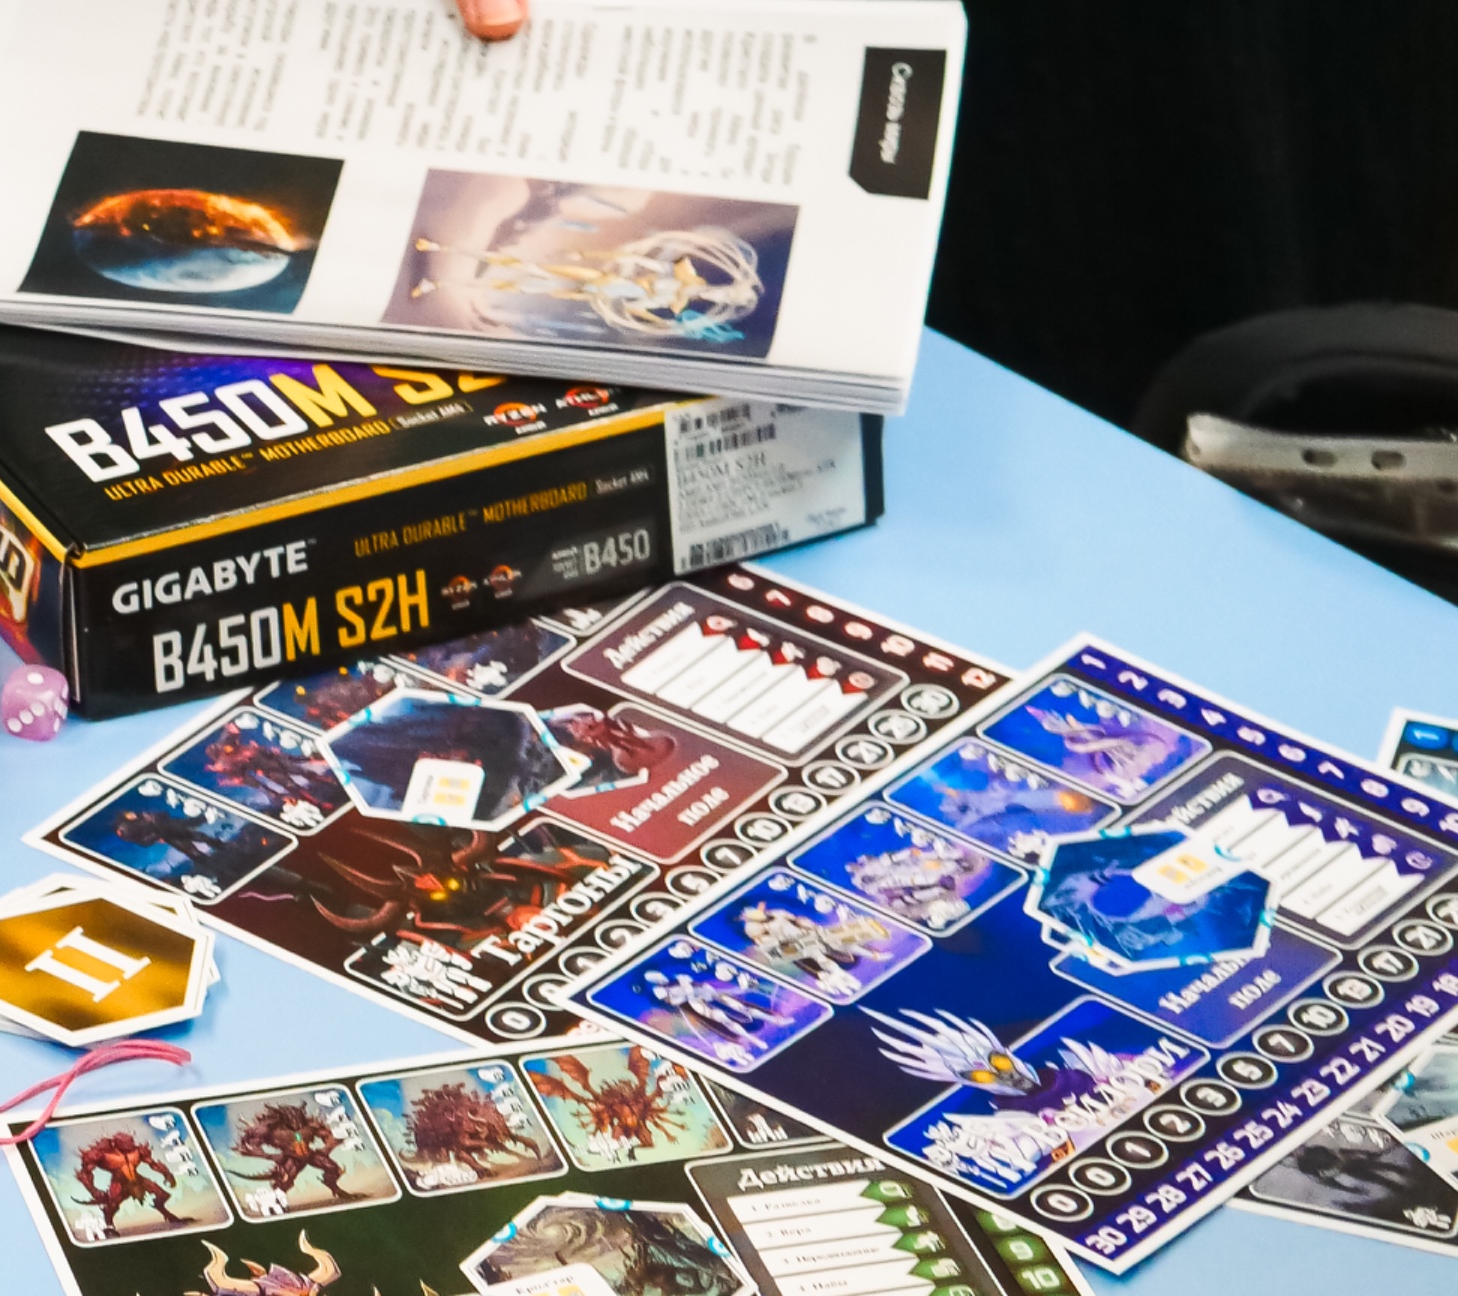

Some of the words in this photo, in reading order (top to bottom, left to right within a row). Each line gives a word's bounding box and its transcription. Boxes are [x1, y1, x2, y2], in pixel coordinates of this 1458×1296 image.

[44, 363, 378, 484] B450M
[103, 472, 164, 502] ULTRA
[259, 417, 391, 462] MOTHERBOARD
[354, 528, 400, 558] ULTRA
[483, 481, 588, 524] MOTHERBOARD
[583, 528, 652, 576] B450
[152, 596, 322, 695] B450M
[335, 567, 431, 649] S2H
[603, 601, 697, 671] Действия
[610, 753, 721, 834] Начальное
[676, 786, 731, 827] поле
[470, 853, 643, 967] Таргоны
[24, 926, 152, 1004] II
[1228, 968, 1282, 1011] поле
[1047, 1193, 1079, 1213] 0
[1086, 1166, 1118, 1186] 0
[1124, 1142, 1152, 1159] 1
[1158, 1113, 1191, 1134] 2
[1196, 1086, 1228, 1108] 3
[1267, 1034, 1296, 1055] 7
[1301, 1005, 1337, 1029] 10
[1371, 951, 1404, 974] 17
[1405, 925, 1442, 950] 21
[1085, 1226, 1128, 1256] 30
[1117, 1206, 1159, 1236] 29
[1145, 1184, 1188, 1215] 28
[1175, 1164, 1211, 1193] 27
[1204, 1142, 1246, 1173] 26
[1233, 1122, 1275, 1152] 25
[1261, 1100, 1304, 1131] 24
[1290, 1078, 1332, 1108] 23
[1319, 1056, 1362, 1087] 22
[1348, 1036, 1386, 1064] 21
[1374, 1013, 1416, 1043] 20
[1404, 994, 1441, 1018] 19
[736, 1157, 887, 1193] Действия
[1021, 1266, 1061, 1290] 10
